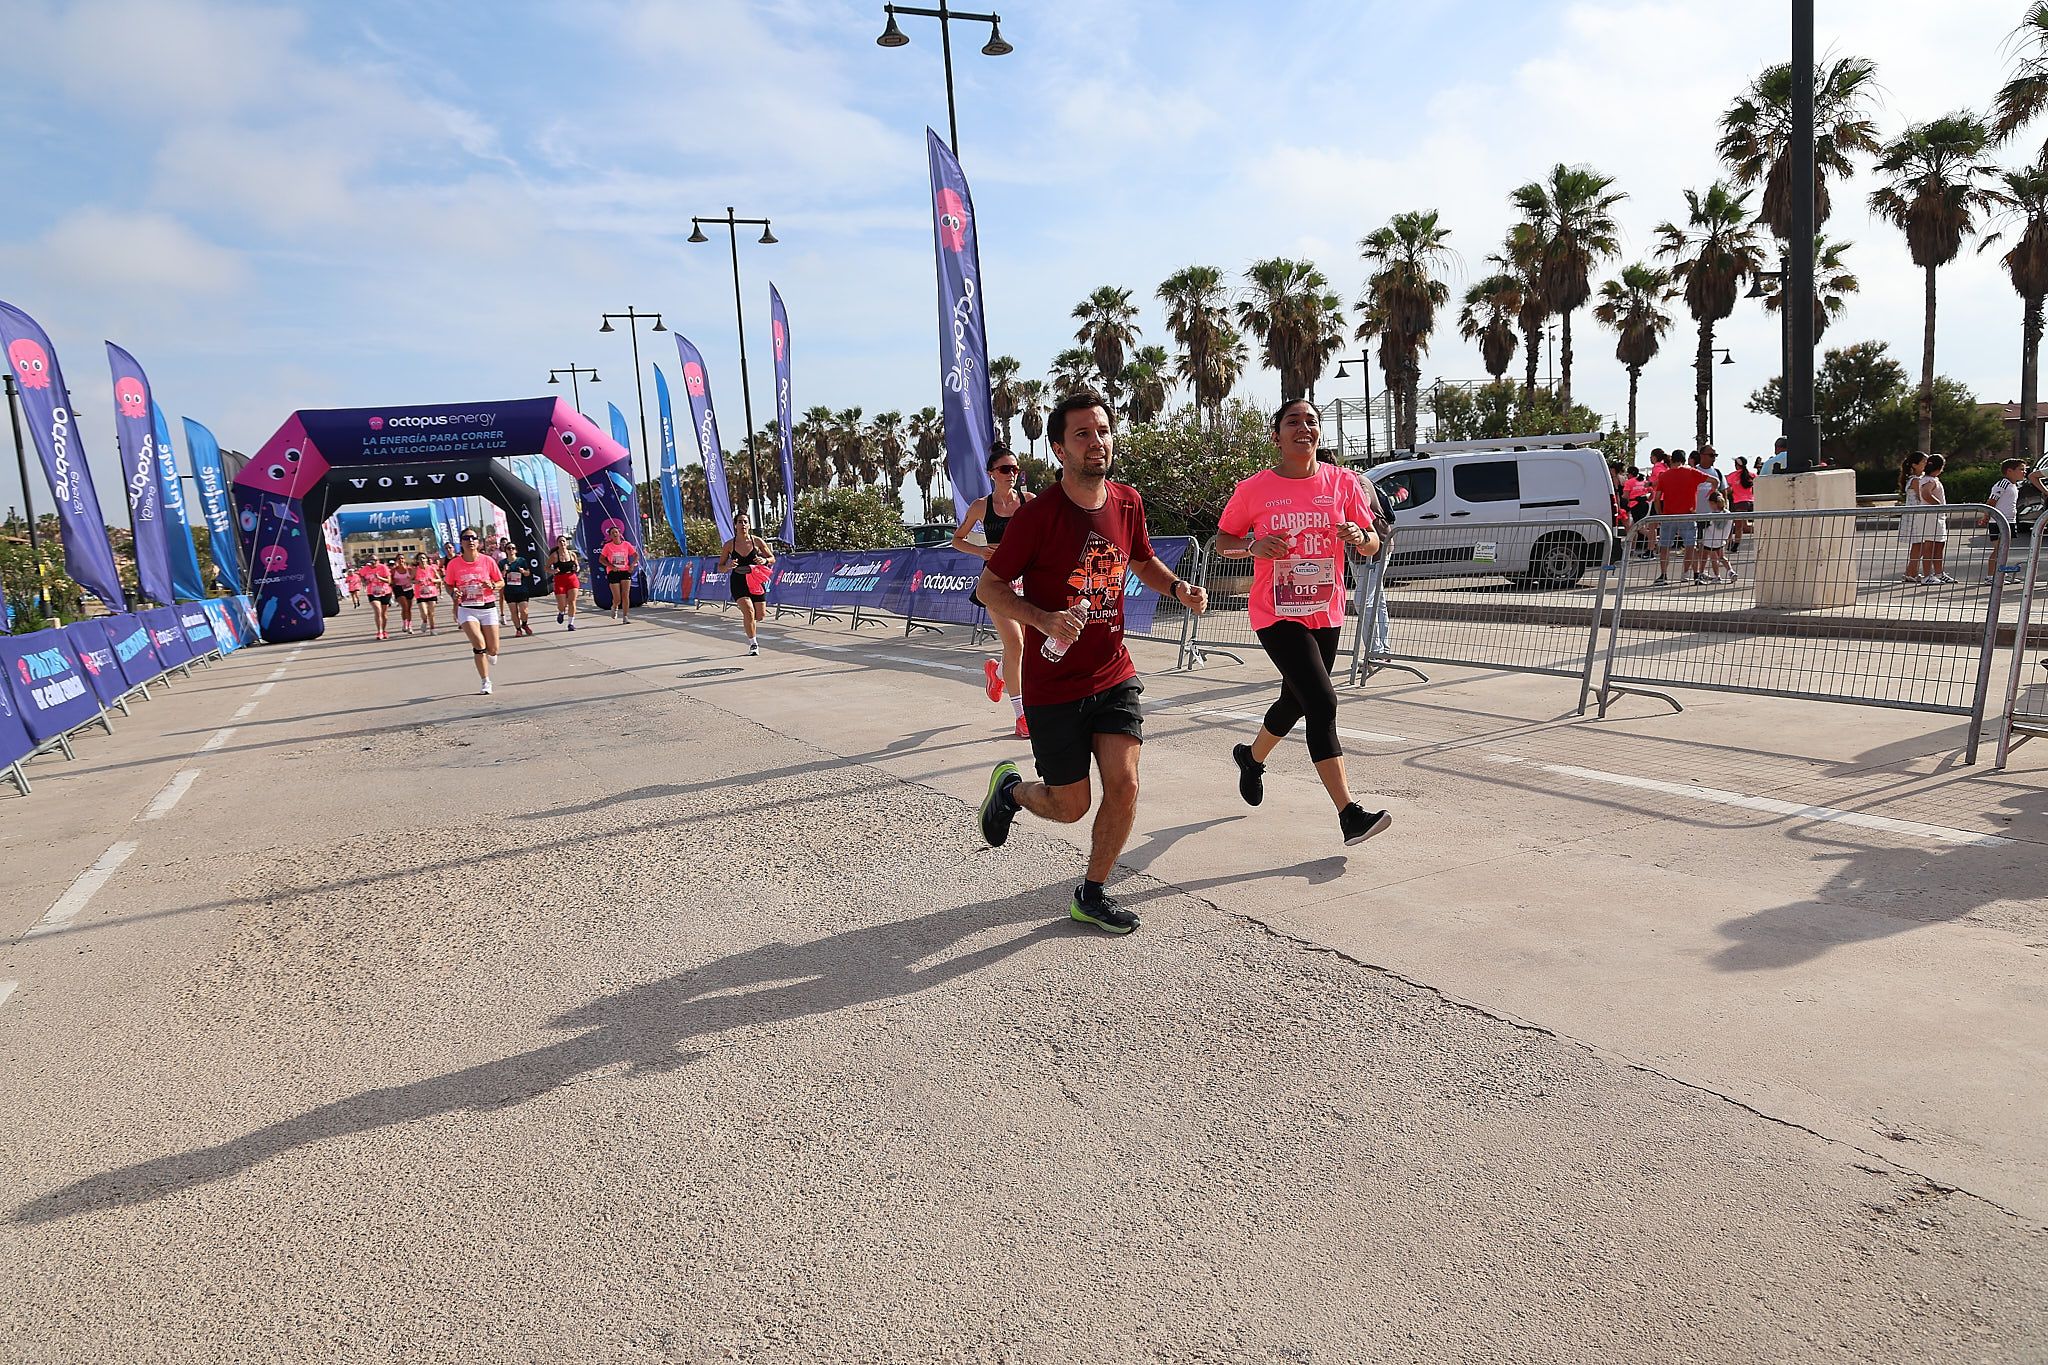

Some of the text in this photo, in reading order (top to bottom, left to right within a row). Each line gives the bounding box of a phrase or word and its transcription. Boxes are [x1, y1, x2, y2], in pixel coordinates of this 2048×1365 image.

[363, 431, 504, 445] LA ENERGÍA PARA CORRER
[374, 447, 388, 455] LA
[390, 444, 452, 454] VELOCIDAD
[349, 472, 469, 489] VOLVO
[1265, 498, 1292, 507] OYSHO
[1271, 512, 1331, 531] CARRERA
[522, 509, 541, 585] VOLVO
[1304, 533, 1322, 555] DE
[1295, 585, 1318, 595] 016
[1087, 608, 1118, 619] CTURNA
